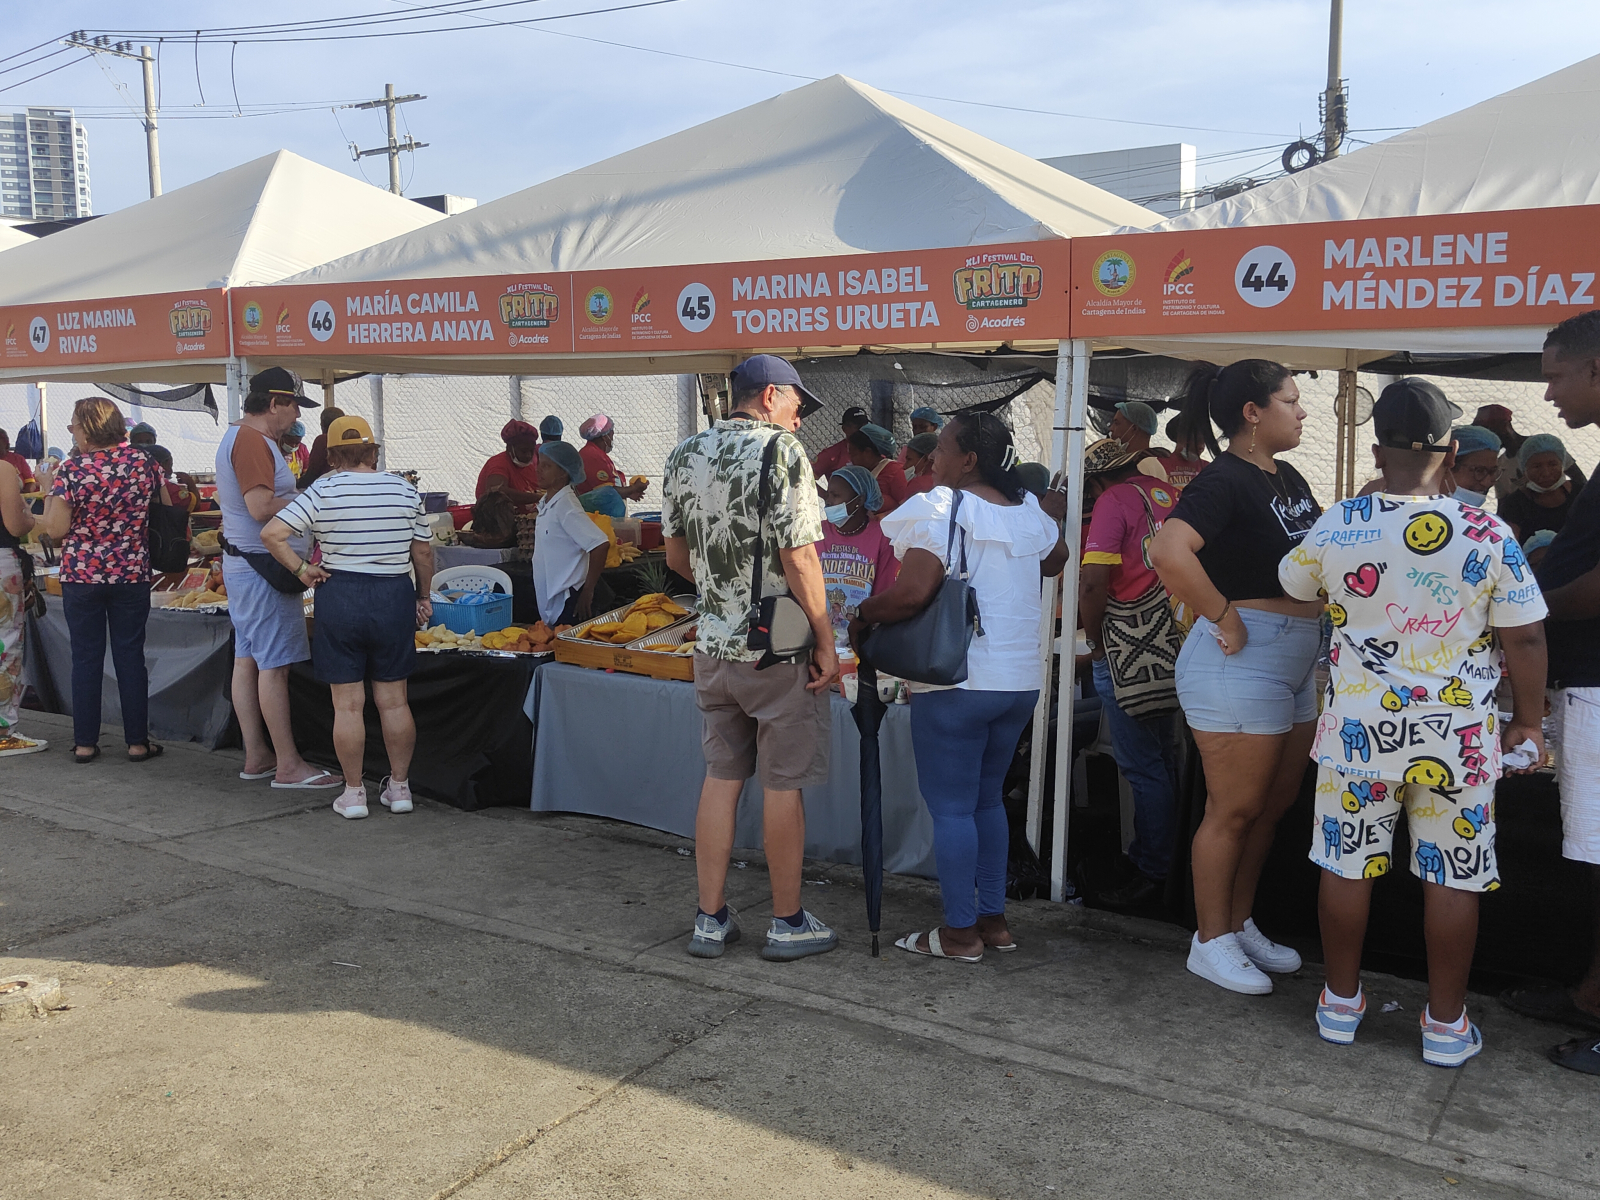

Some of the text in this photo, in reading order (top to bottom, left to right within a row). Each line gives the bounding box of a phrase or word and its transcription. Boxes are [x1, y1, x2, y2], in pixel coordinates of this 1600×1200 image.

[966, 252, 1035, 267] XLI FESTIVAL DEL
[1324, 231, 1508, 269] MARLENE
[518, 283, 542, 291] FESTIVAL
[732, 266, 929, 301] MARINA ISABEL
[954, 262, 1043, 305] FRITO
[1241, 262, 1289, 292] 44
[1322, 265, 1595, 310] MÉNDEZ DÍAZ
[1163, 283, 1194, 295] IPCC
[346, 289, 480, 316] MARÍA CAMILA
[499, 291, 559, 324] FRITO
[681, 295, 711, 320] 45
[972, 298, 1023, 308] CARTAGENERO
[1081, 308, 1115, 317] Cartagena
[1124, 307, 1146, 315] Indias
[1113, 299, 1133, 307] Mayor
[1134, 298, 1142, 306] de
[57, 308, 137, 331] LUZ MARINA
[169, 306, 212, 335] FRITO
[311, 311, 333, 332] 46
[631, 313, 652, 323] IPCC
[732, 301, 940, 333] TORRES URUETA
[981, 315, 1026, 328] Acodrés
[32, 325, 47, 344] 47
[276, 324, 290, 333] IPCC
[348, 320, 495, 343] HERRERA ANAYA
[518, 334, 549, 344] Acodrés
[5, 338, 17, 346] IPCC
[59, 335, 98, 354] RIVAS
[183, 342, 206, 351] Acodrés
[831, 544, 851, 552] FIESTAS
[821, 559, 876, 582] NDELARIA
[1406, 567, 1459, 605] Style
[1385, 602, 1465, 637] CRAZY
[1458, 659, 1498, 680] MAGIC
[1368, 716, 1425, 754] LOVE
[1444, 844, 1491, 879] LOVE
